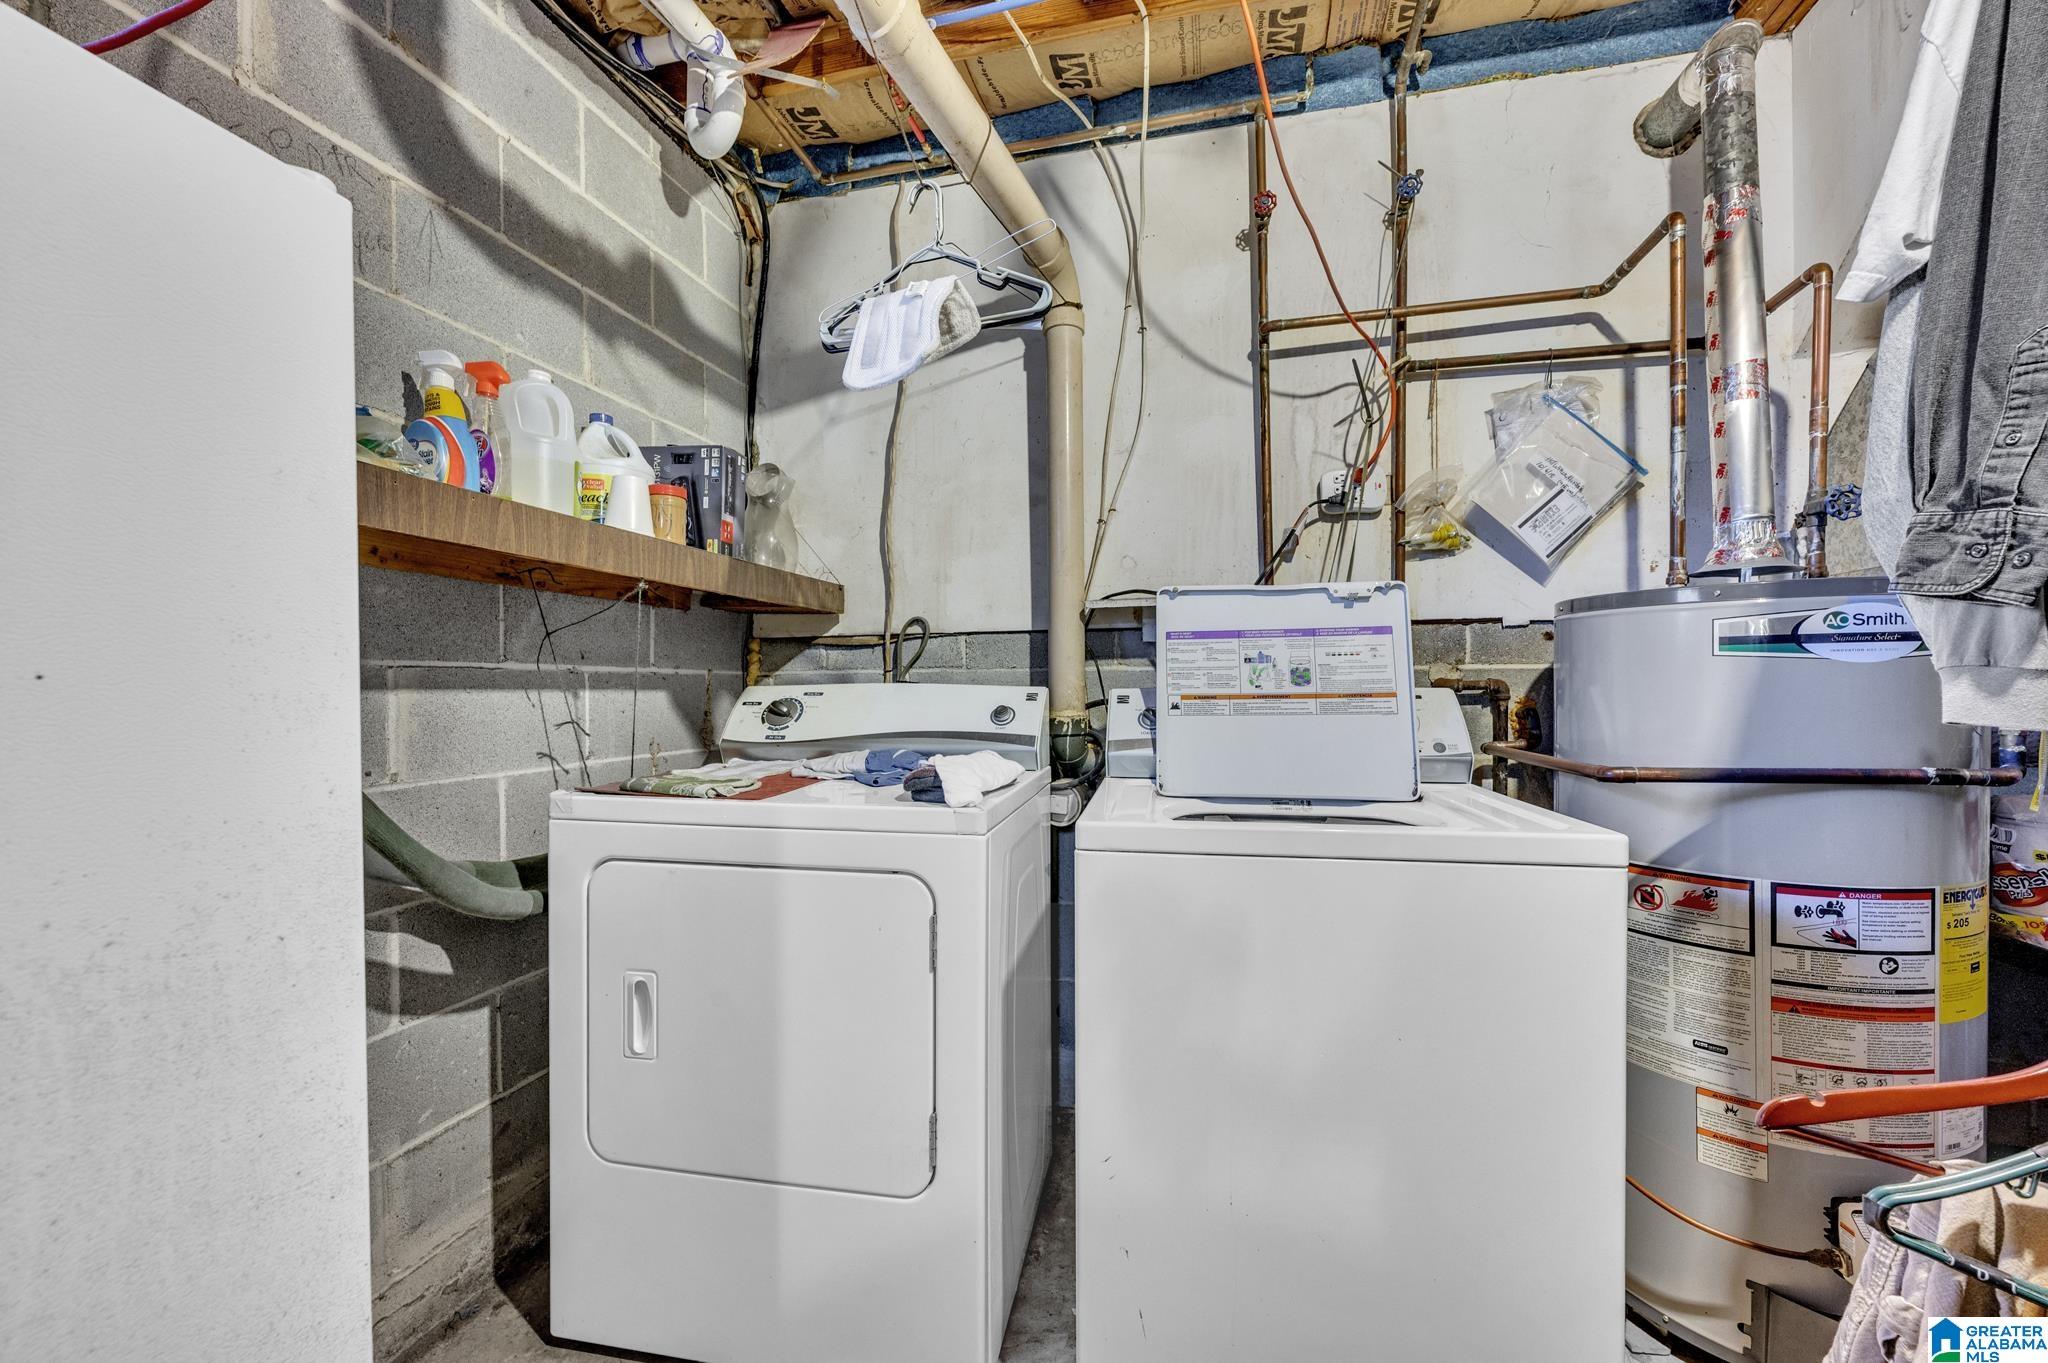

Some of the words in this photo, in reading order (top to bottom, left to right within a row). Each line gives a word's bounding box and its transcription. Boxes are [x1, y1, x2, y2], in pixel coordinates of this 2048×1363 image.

[1049, 53, 1093, 90] JM
[1853, 611, 1905, 627] Smith
[1831, 633, 1872, 643] Signature
[1874, 632, 1898, 642] Select
[1657, 871, 1690, 883] WARNING
[1849, 892, 1882, 900] DANGER
[1946, 921, 1952, 930] $
[1953, 917, 1970, 929] 205
[1719, 1094, 1750, 1106] WARNING
[1719, 1135, 1751, 1148] WARNING
